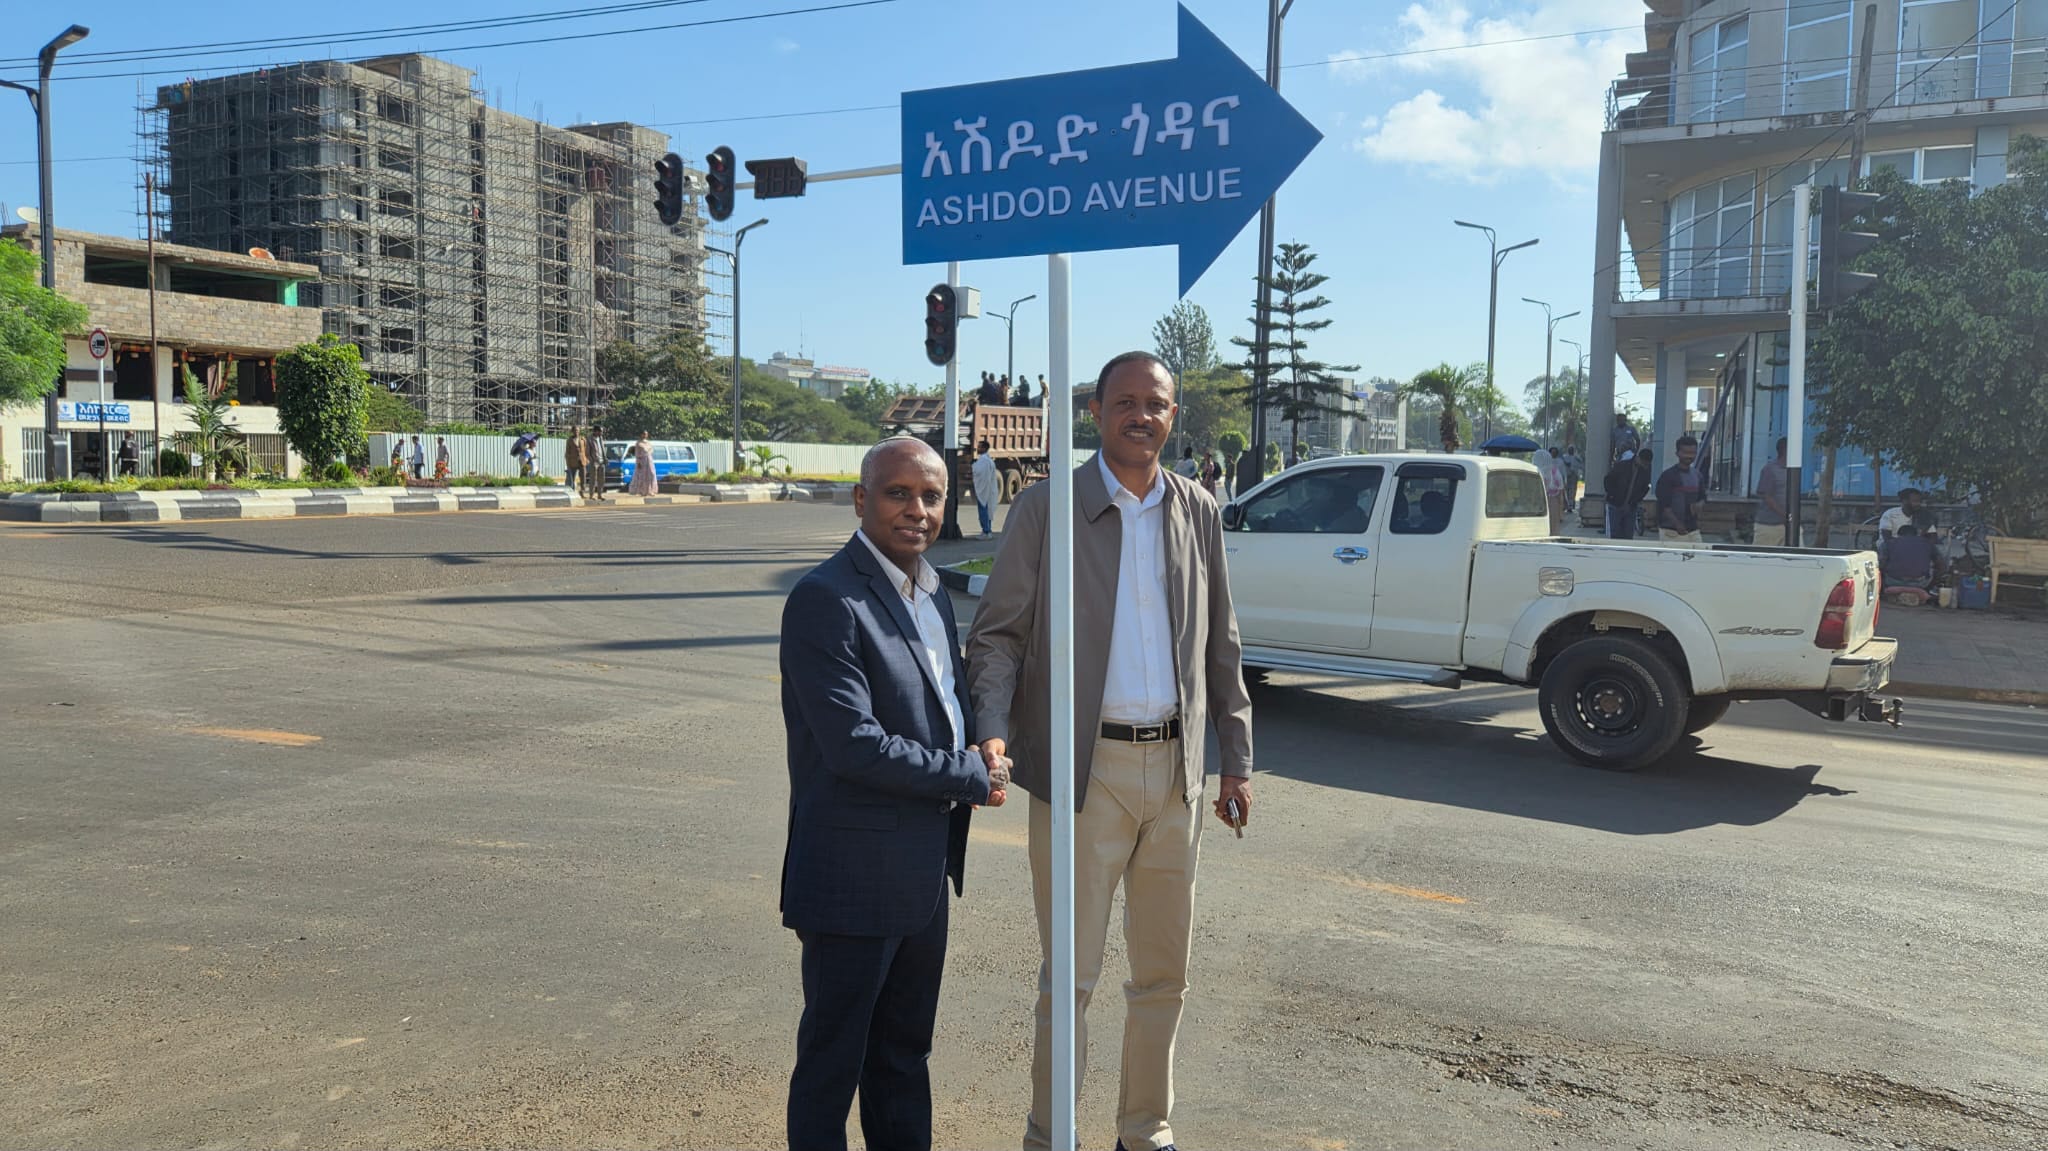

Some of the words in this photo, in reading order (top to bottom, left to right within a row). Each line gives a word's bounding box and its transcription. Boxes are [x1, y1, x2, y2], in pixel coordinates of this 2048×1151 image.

[921, 114, 1098, 178] አሽዶድ
[1121, 95, 1241, 156] ጎዳና
[916, 186, 1072, 228] ASHDOD
[1082, 167, 1243, 213] AVENUE
